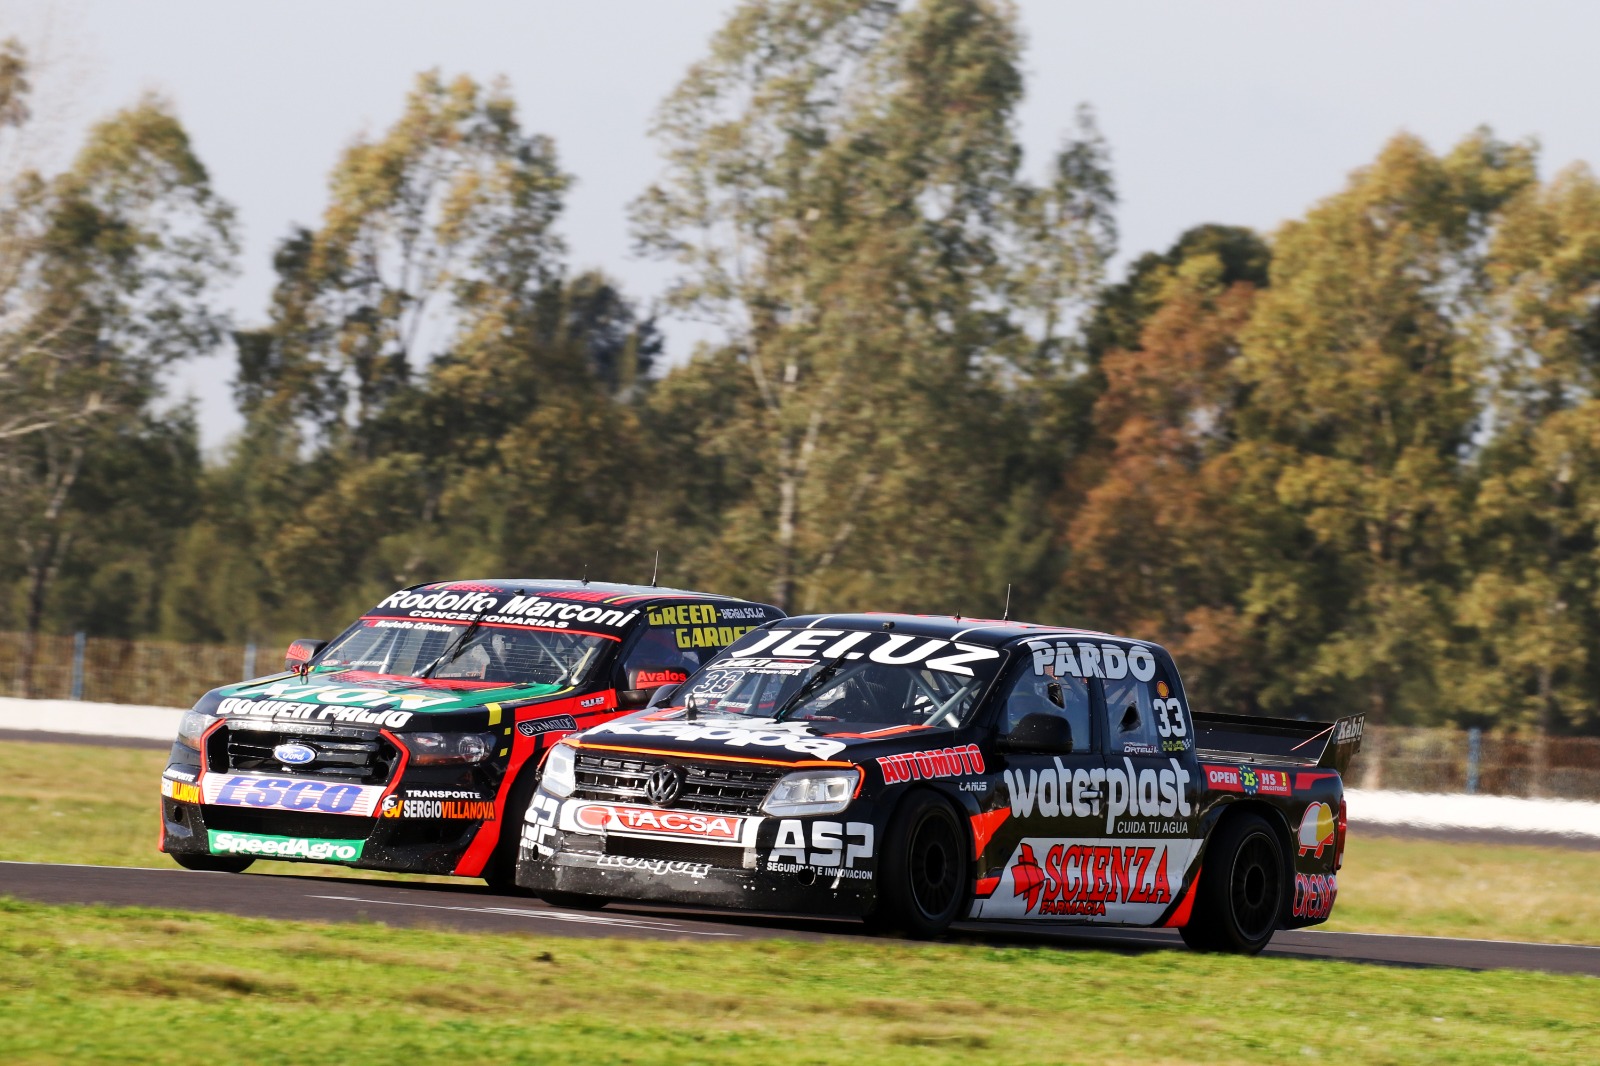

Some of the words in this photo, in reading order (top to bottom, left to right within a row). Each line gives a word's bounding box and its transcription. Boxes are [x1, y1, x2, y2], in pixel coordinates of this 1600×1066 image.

[377, 590, 498, 613] Rodolfo
[498, 595, 641, 628] Marconi
[408, 609, 569, 629] CONCESIONARIAS
[731, 629, 999, 677] JELUZ
[1026, 642, 1156, 682] PARDO
[636, 669, 687, 682] Avalos
[692, 669, 745, 694] 33
[1152, 697, 1187, 738] 33
[281, 747, 307, 762] Ford
[876, 743, 985, 785] AUTOMOTO
[1209, 770, 1238, 785] OPEN
[1243, 772, 1256, 787] 25
[1261, 772, 1277, 786] HS
[214, 775, 363, 813] ESCO
[405, 789, 482, 799] TRANSPORTE
[1003, 757, 1191, 835] waterplast
[623, 810, 733, 835] TACSA
[1116, 821, 1147, 834] CUIDA
[1148, 822, 1161, 833] TU
[1161, 822, 1189, 834] AGUA
[213, 832, 357, 860] SpeedAgro
[767, 819, 875, 868] ASP
[825, 867, 873, 880] INNOVACION
[1045, 843, 1172, 904] SCIENZA
[1038, 901, 1107, 916] FARMACIA
